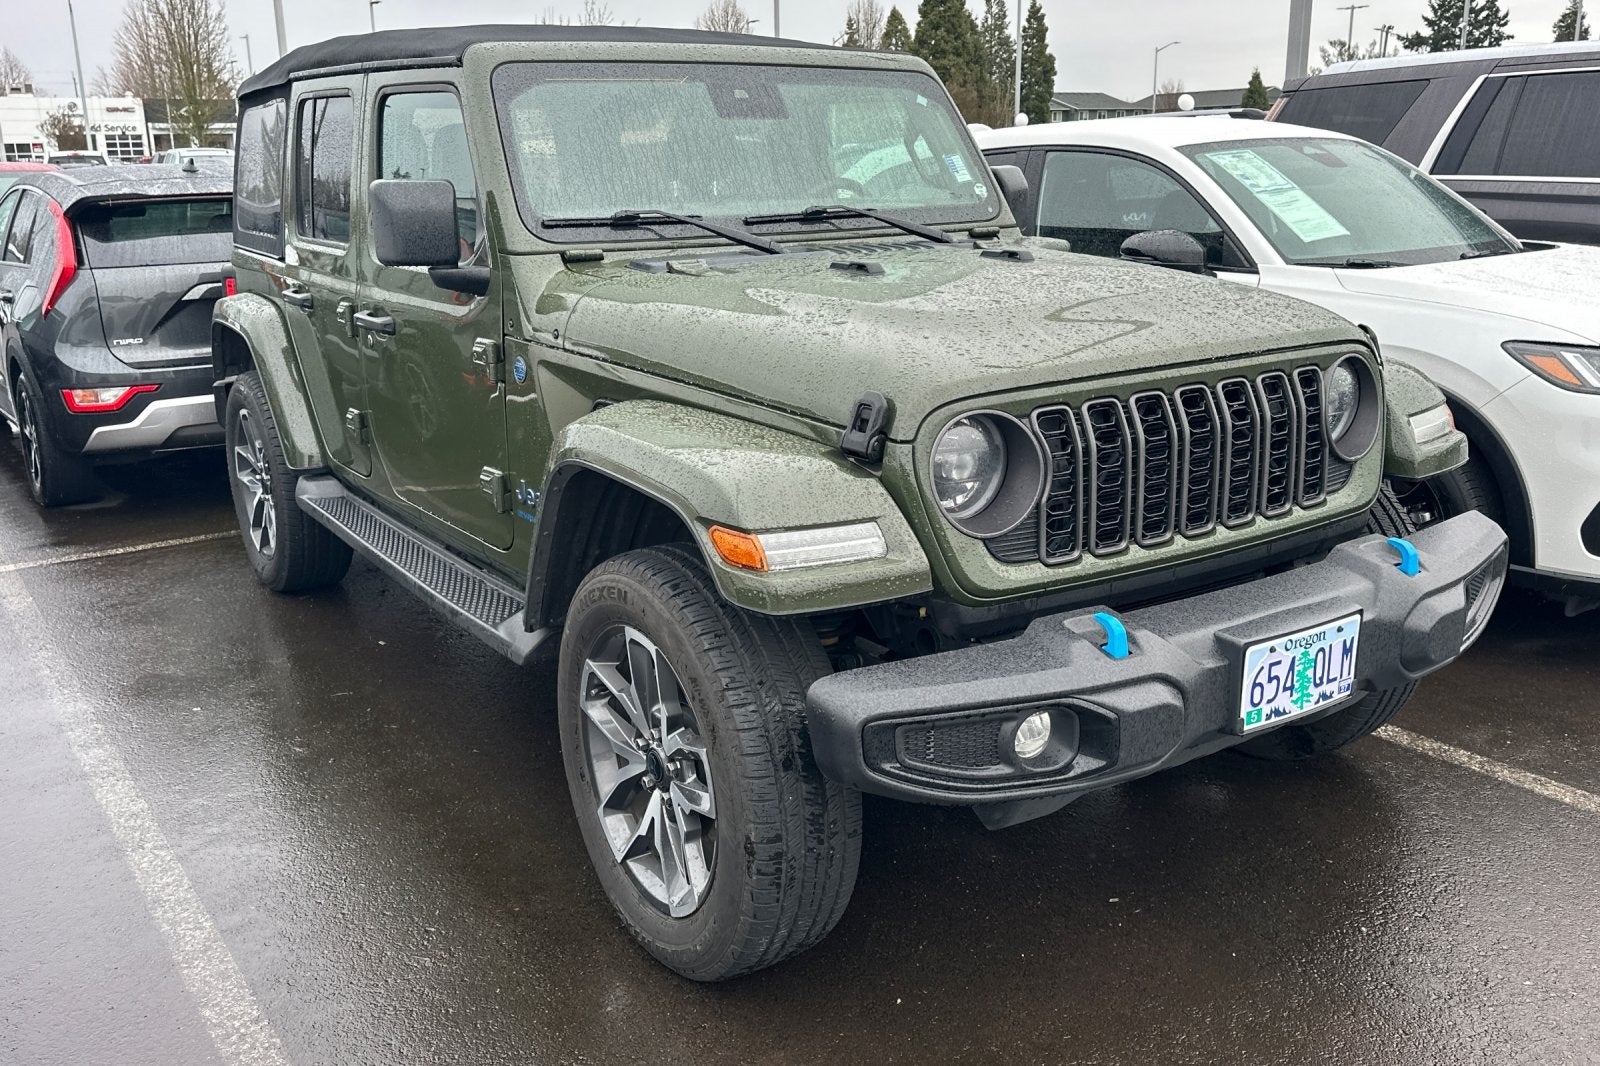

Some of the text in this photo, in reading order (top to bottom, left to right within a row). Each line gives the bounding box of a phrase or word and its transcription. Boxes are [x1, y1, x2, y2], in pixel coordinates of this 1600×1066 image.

[104, 124, 137, 132] Service
[578, 585, 628, 613] NEXEN
[1284, 630, 1327, 651] Oregon
[1250, 636, 1355, 708] 654 QLM
[1250, 712, 1258, 723] 5
